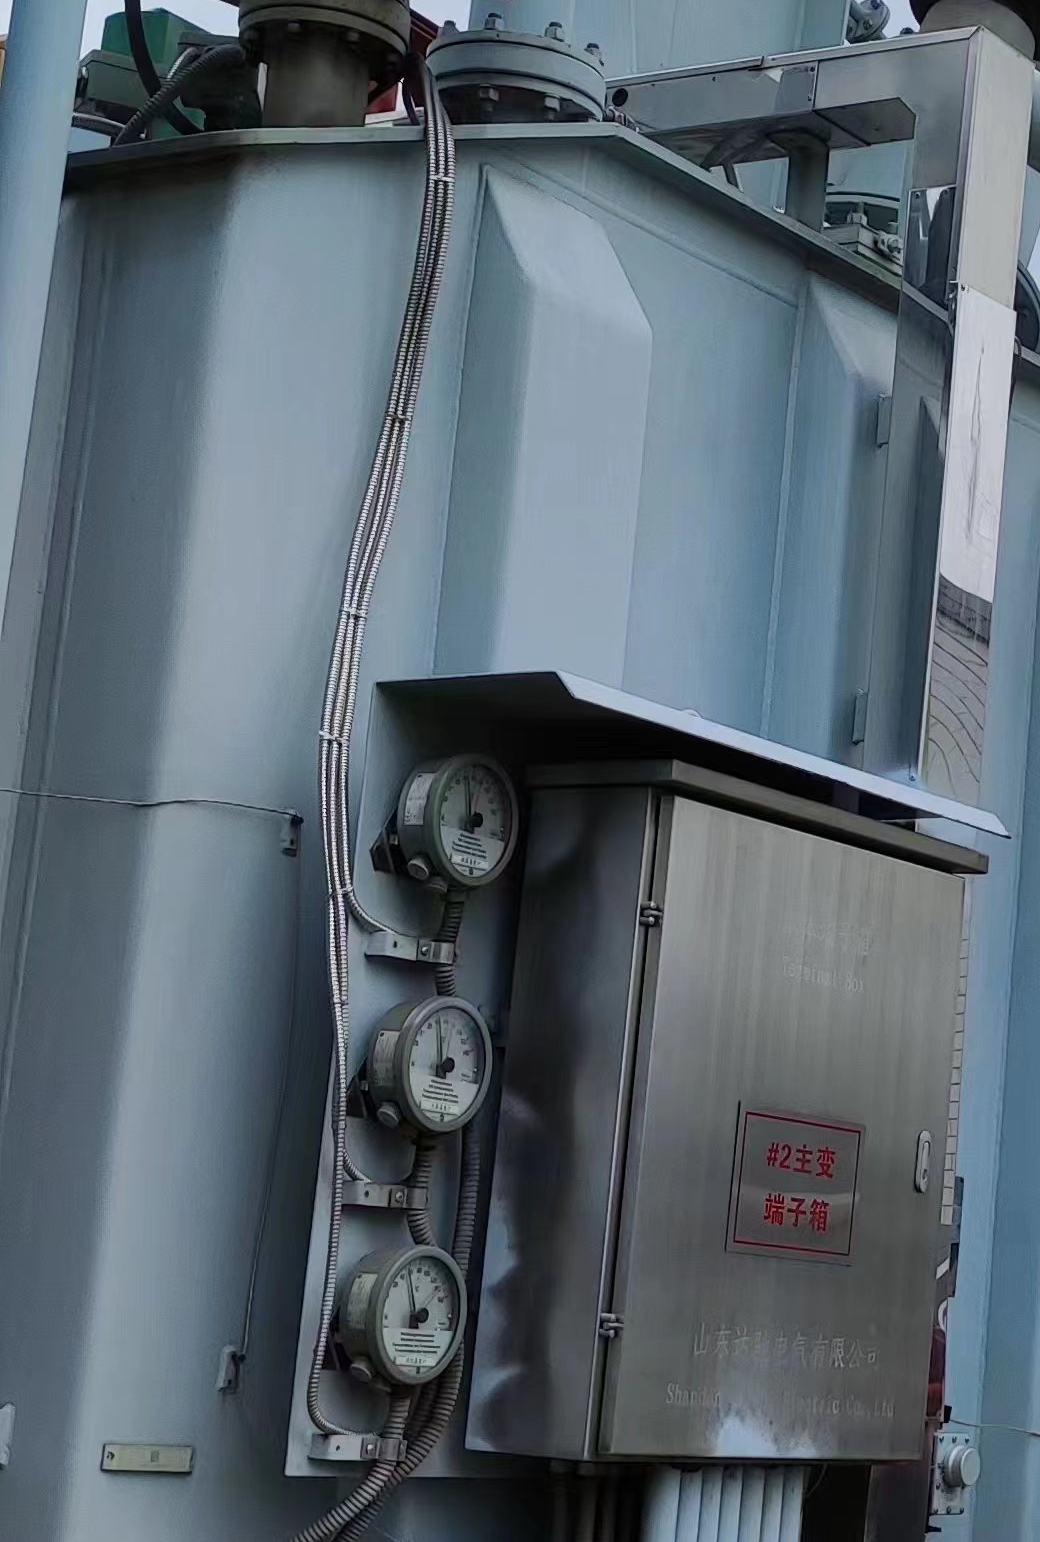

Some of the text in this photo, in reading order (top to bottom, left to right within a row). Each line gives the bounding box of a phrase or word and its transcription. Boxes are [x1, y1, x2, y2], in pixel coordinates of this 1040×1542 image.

[767, 1142, 836, 1178] #2主变
[764, 1193, 829, 1232] 端子箱
